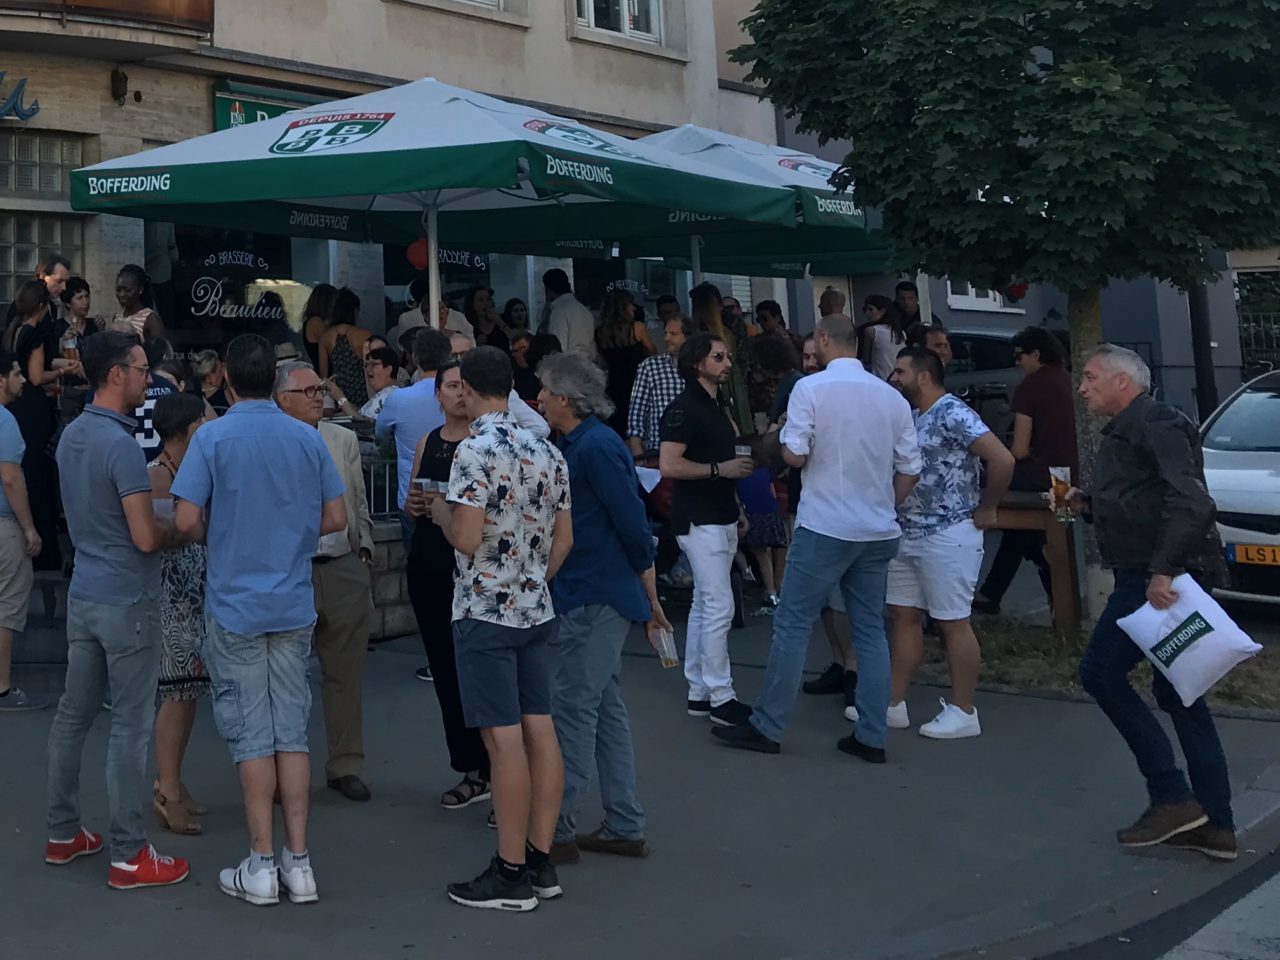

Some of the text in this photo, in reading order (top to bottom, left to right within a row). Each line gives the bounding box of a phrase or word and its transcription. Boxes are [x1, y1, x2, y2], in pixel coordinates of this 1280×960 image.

[298, 112, 386, 127] DEPUIS 1764
[545, 154, 614, 185] BOFFERDING
[88, 173, 171, 195] BOFFERDING
[218, 250, 255, 268] BRASSERIE
[438, 248, 471, 267] RASSERIE
[191, 276, 284, 320] Beaulieu
[1156, 618, 1207, 662] BOFFERDING
